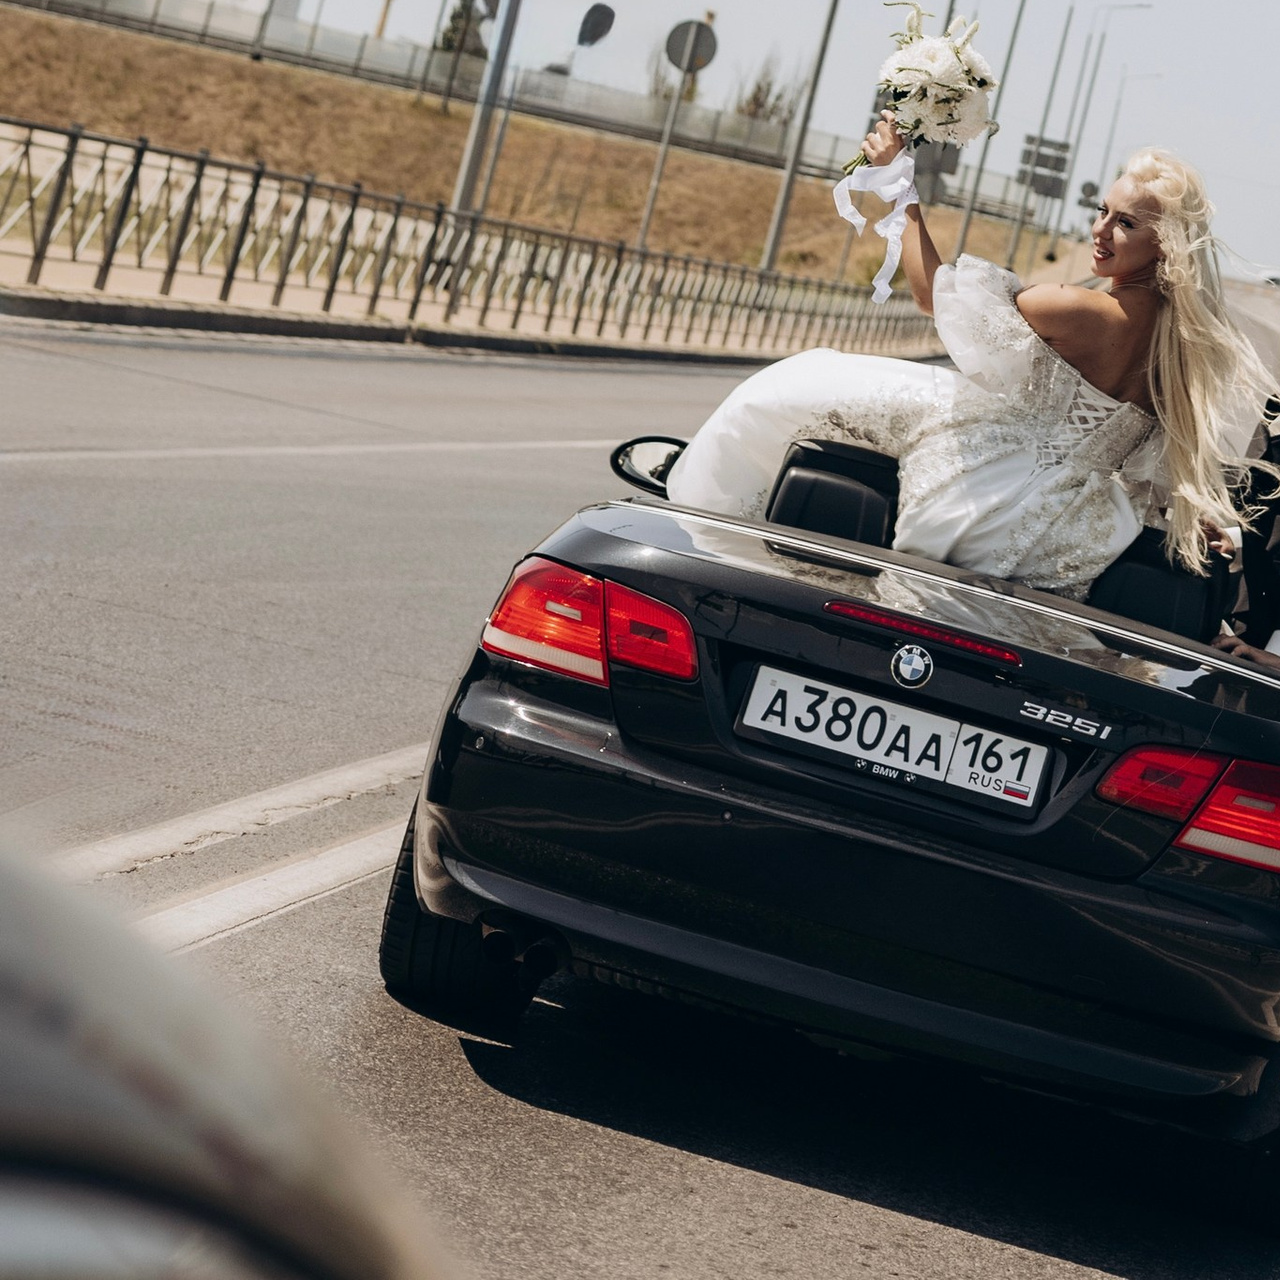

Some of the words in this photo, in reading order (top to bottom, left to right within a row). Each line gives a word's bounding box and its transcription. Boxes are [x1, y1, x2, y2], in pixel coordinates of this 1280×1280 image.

[962, 732, 1032, 782] 161
[872, 764, 899, 780] BMW
[968, 771, 1003, 792] RUS
